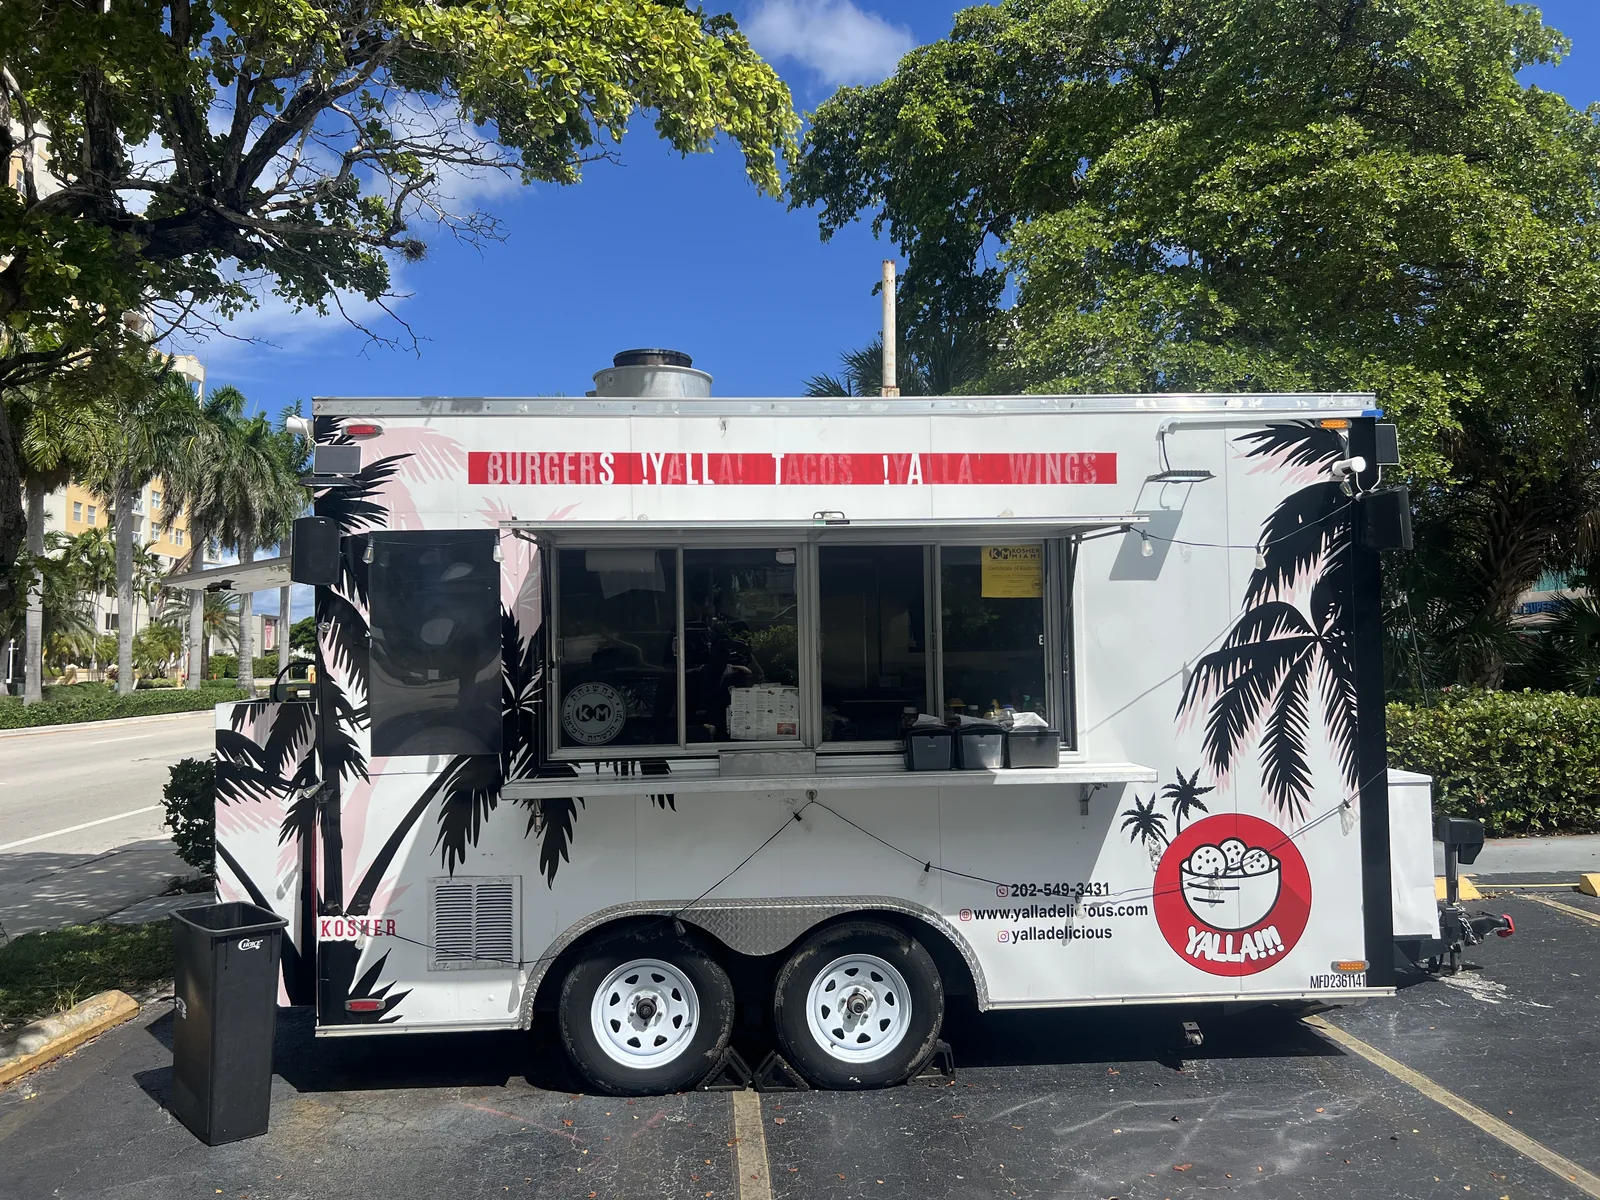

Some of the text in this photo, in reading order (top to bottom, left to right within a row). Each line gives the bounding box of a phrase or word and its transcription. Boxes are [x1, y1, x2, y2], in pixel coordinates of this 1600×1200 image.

[487, 452, 614, 485] BURGERS
[772, 452, 853, 485] TACOS
[882, 453, 982, 485] !YALLA
[1009, 453, 1097, 485] WINGS
[577, 704, 610, 721] KM
[1011, 882, 1110, 897] 202-549-3431
[974, 904, 1148, 923] www.yalladeliious.com
[321, 919, 396, 937] KOSHER
[1011, 926, 1113, 944] yalladelicious
[1185, 925, 1285, 963] YALLA!!!
[1310, 974, 1366, 988] MFD2361141
